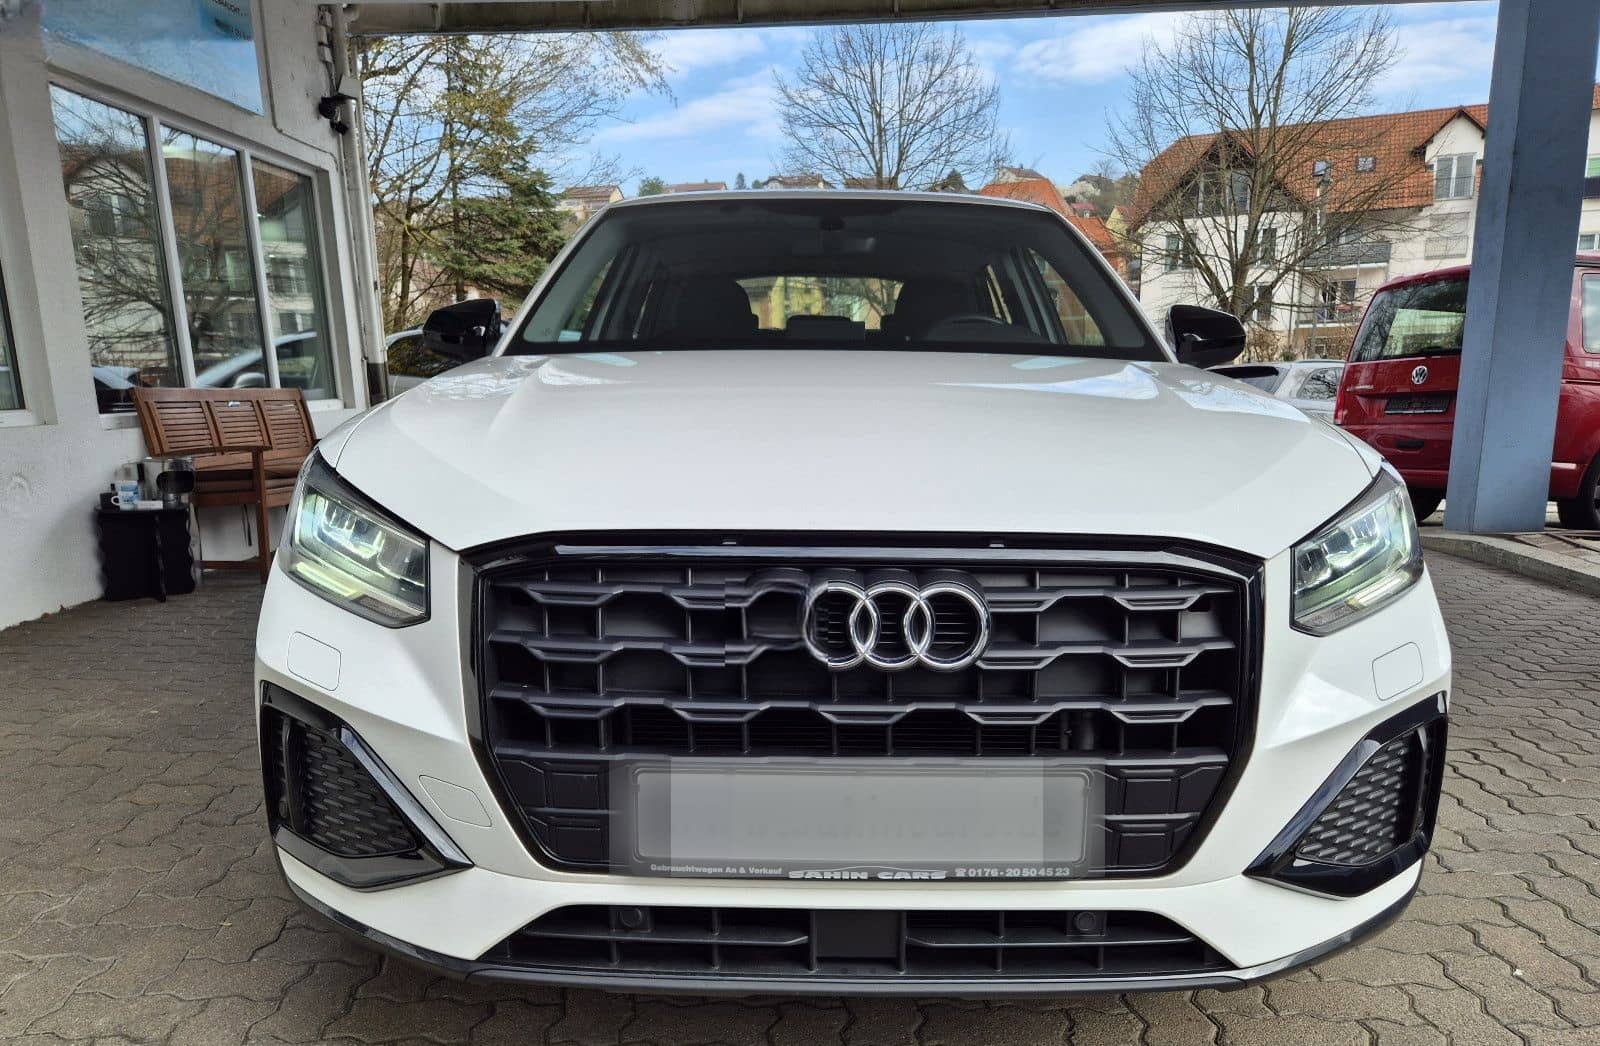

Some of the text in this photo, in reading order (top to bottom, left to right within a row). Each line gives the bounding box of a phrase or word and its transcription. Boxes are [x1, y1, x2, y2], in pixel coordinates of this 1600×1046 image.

[725, 866, 737, 874] An
[739, 866, 747, 874] &
[749, 866, 782, 875] Verkauf
[788, 871, 948, 879] SAHIN CARS
